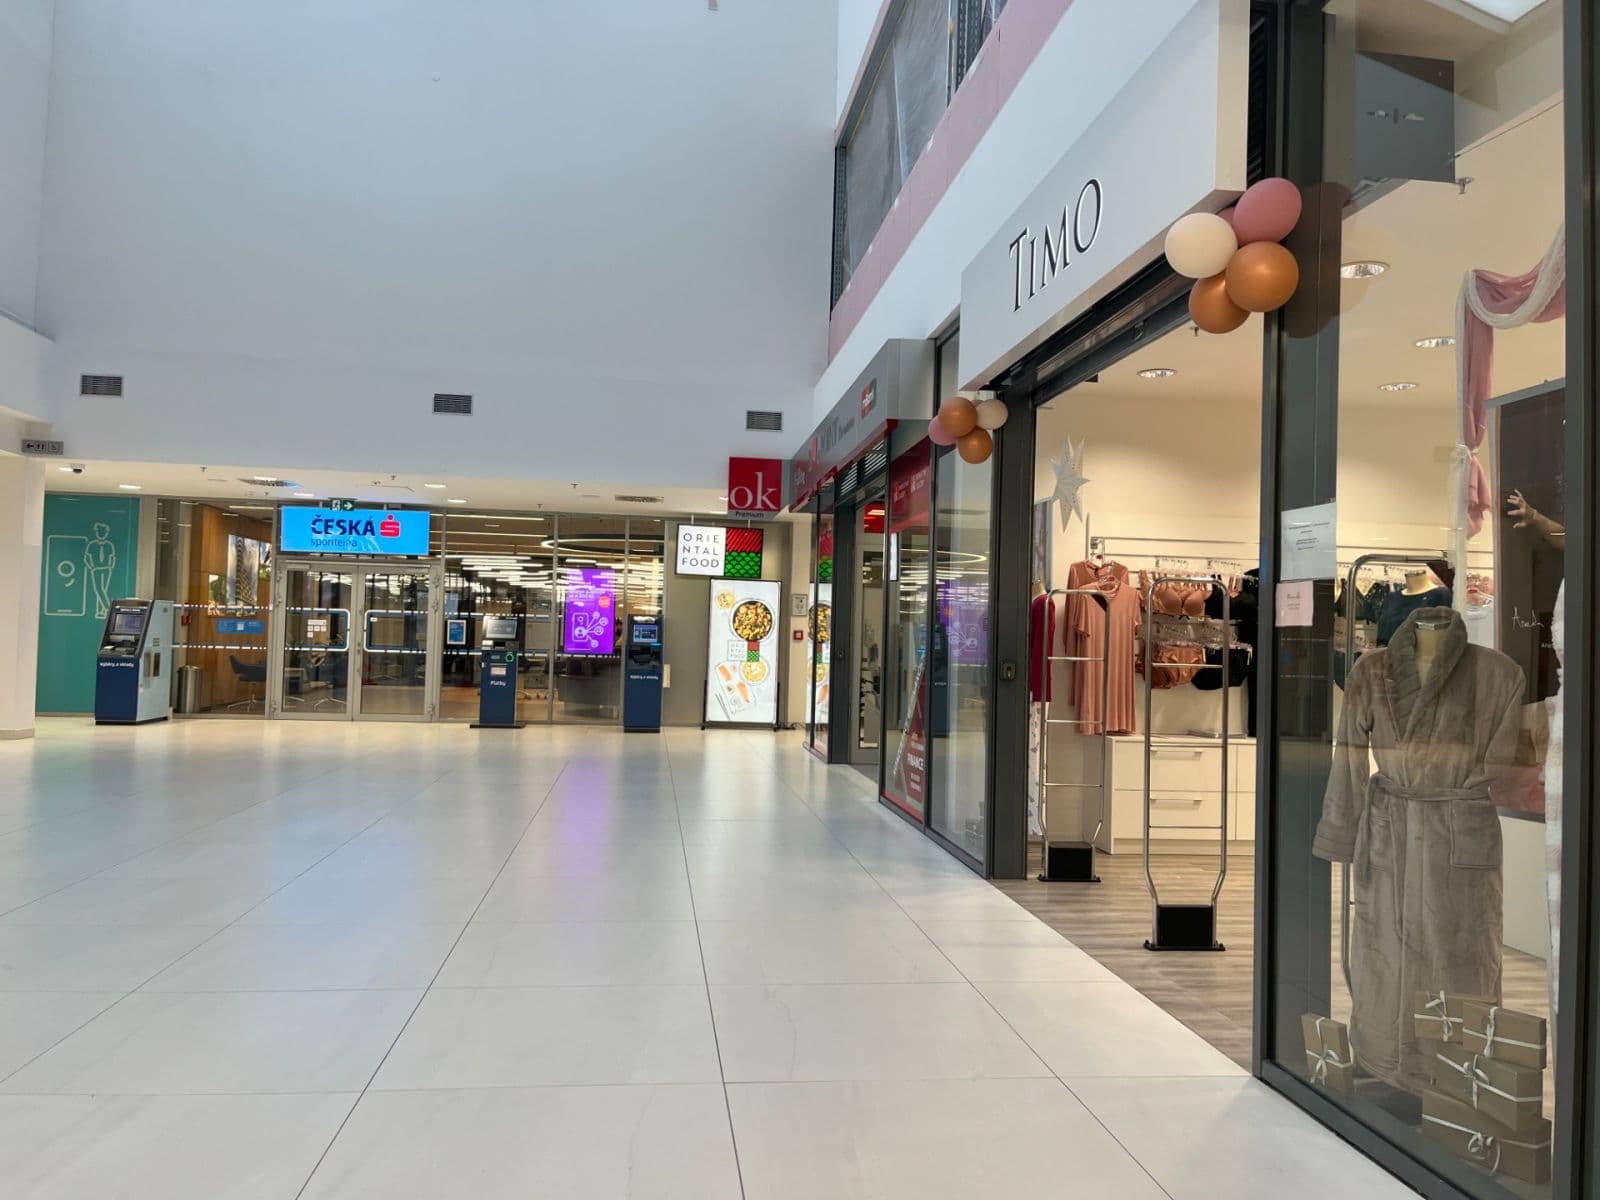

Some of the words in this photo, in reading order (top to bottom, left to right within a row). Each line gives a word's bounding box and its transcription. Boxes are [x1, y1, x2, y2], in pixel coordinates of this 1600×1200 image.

[729, 471, 780, 510] ok
[311, 514, 376, 537] ČESKÁ
[681, 557, 720, 568] FOOD
